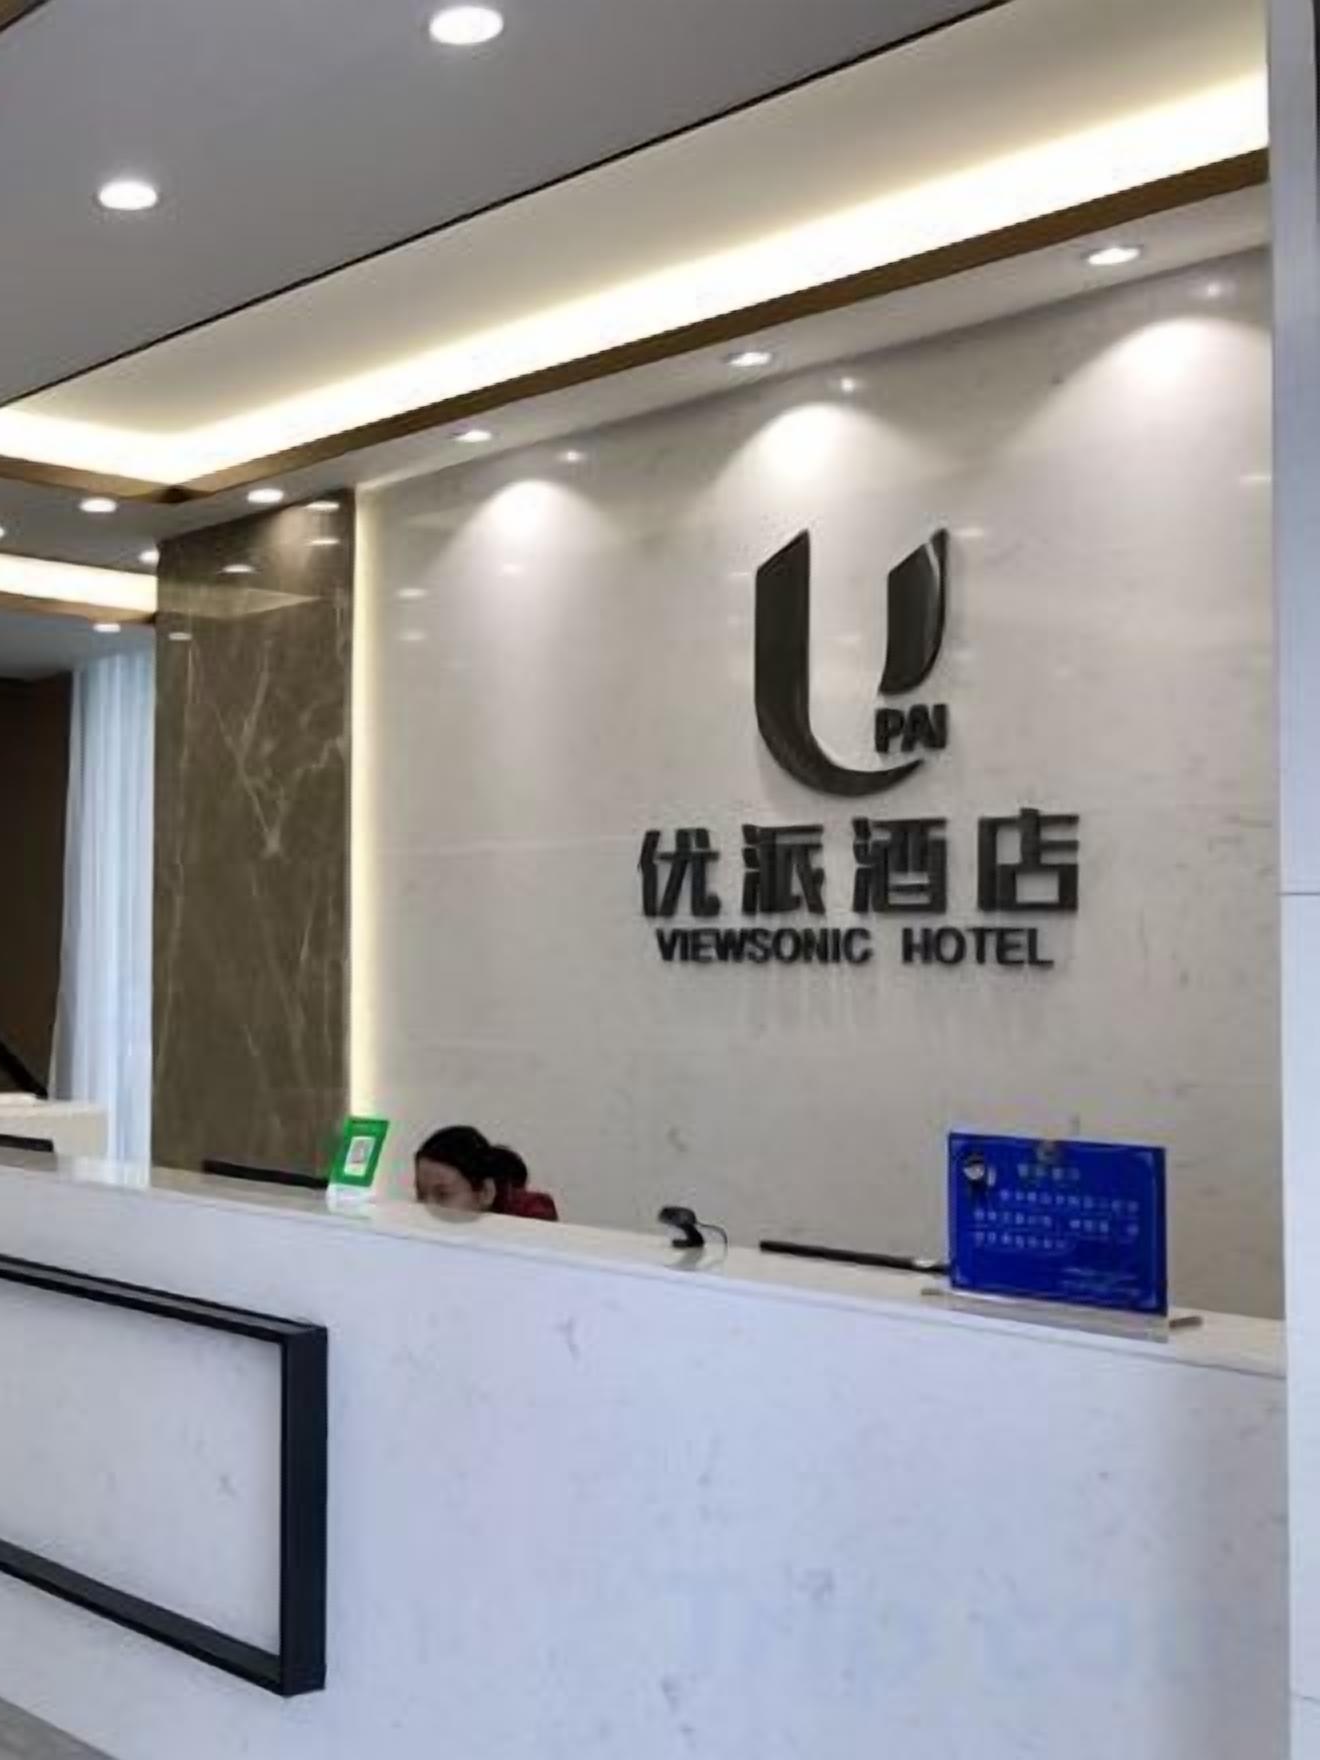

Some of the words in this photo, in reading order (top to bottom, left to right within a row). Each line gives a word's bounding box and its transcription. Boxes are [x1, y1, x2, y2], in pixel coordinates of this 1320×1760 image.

[874, 703, 948, 753] PAI
[638, 807, 1080, 917] 优派酒店
[656, 927, 874, 966] VIEWSONIC
[901, 926, 1054, 967] HOTEL
